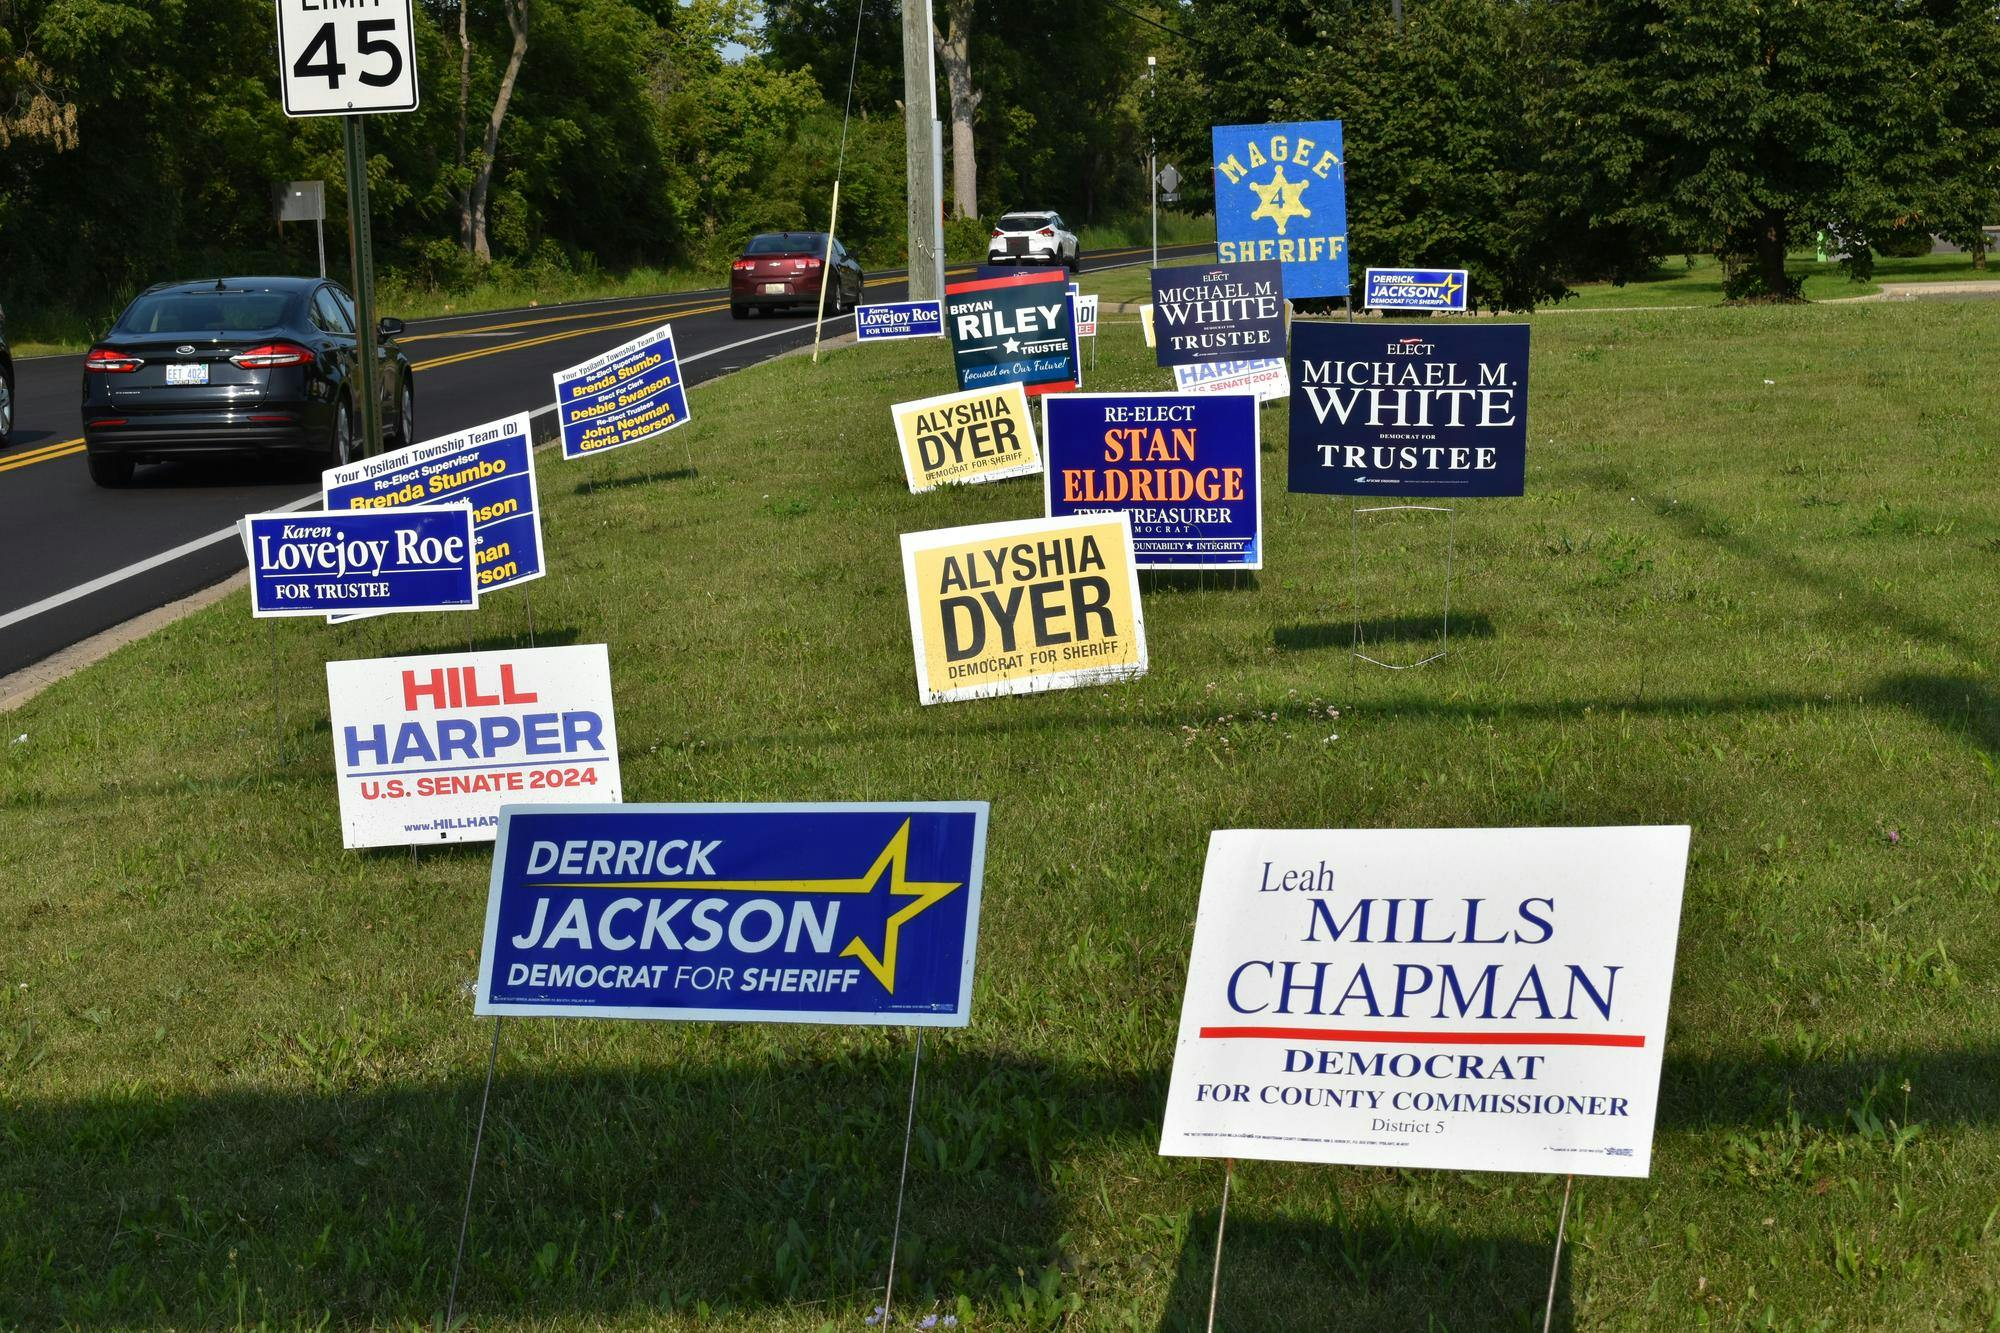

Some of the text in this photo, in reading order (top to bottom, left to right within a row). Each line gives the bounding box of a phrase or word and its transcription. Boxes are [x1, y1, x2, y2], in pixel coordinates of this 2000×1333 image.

[293, 18, 403, 90] 45
[1218, 135, 1339, 185] MAGEE
[1269, 185, 1286, 209] 4
[1219, 236, 1345, 264] SHERIFF
[1158, 281, 1278, 304] MICHAEL M.
[1202, 273, 1230, 283] ELECT
[1370, 285, 1439, 298] JACKSON
[1372, 275, 1415, 283] DERRICK
[859, 308, 938, 326] Lovejoy Roe
[949, 300, 993, 315] BRYAN
[957, 303, 1062, 341] RILEY
[1159, 296, 1279, 327] WHITE
[881, 326, 911, 334] TRUSTEE
[1170, 329, 1271, 351] TRUSTEE
[561, 331, 666, 382] Your Ypsilanti Township Team (D)
[1020, 342, 1069, 355] TRUSTEE
[1386, 343, 1435, 355] ELECT
[187, 368, 207, 379] 4023
[572, 353, 662, 398] Brenda Stumbo
[586, 351, 646, 383] Re-Elect Supervisor
[1012, 362, 1032, 374] Our
[1210, 376, 1251, 392] SENATE
[1252, 371, 1279, 383] 2024
[1301, 359, 1518, 387] MICHAEL M.
[570, 375, 672, 421] Debbie Swanson
[598, 378, 644, 403] Elect For Clerk
[1301, 386, 1517, 427] WHITE
[582, 402, 670, 440] John Newman
[596, 401, 655, 426] Re-Elect Trustees
[915, 396, 1012, 436] ALYSHIA
[1104, 405, 1196, 422] RE-ELECT
[580, 413, 676, 451] Gloria Peterson
[916, 417, 1022, 472] DYER
[1104, 427, 1197, 463] STAN
[334, 421, 519, 486] Your Ypsilanti Township Team (D)
[925, 463, 969, 481] DEMOCRAT
[971, 458, 988, 469] FOR
[990, 451, 1024, 466] SHERIFF
[1317, 444, 1497, 470] TRUSTEE
[350, 458, 507, 510] Brenda Stumbo
[374, 451, 481, 491] Re-Elect Supervisor
[1061, 467, 1245, 502] ELDRIDGE
[281, 524, 333, 541] Karen
[1134, 525, 1191, 533] MOCRAT
[258, 529, 465, 578] Lovejoy Roe
[1133, 542, 1244, 551] OUNTABILTY INTEGRITY
[939, 534, 1106, 595] ALYSHIA
[275, 582, 391, 600] FOR TRUSTEE
[939, 575, 1118, 663] DYER
[948, 640, 1120, 680] DEMOCRAT FOR SHERIFF
[401, 663, 538, 712] HILL
[343, 710, 606, 767] HARPER
[360, 767, 598, 800] U.S. SENATE 2024
[403, 815, 499, 832] www.HILLHAR
[525, 839, 723, 876] DERRICK
[1257, 860, 1335, 893] Leah
[512, 896, 841, 954] JACKSON
[1299, 896, 1556, 945] MILLS
[507, 963, 861, 993] DEMOCRAT FOR SHERIFF
[1226, 959, 1625, 1022] CHAPMAN
[1281, 1048, 1546, 1082] DEMOCRAT
[1195, 1082, 1630, 1118] FOR COUNTY COMMISSIONER
[1370, 1116, 1446, 1135] District 5
